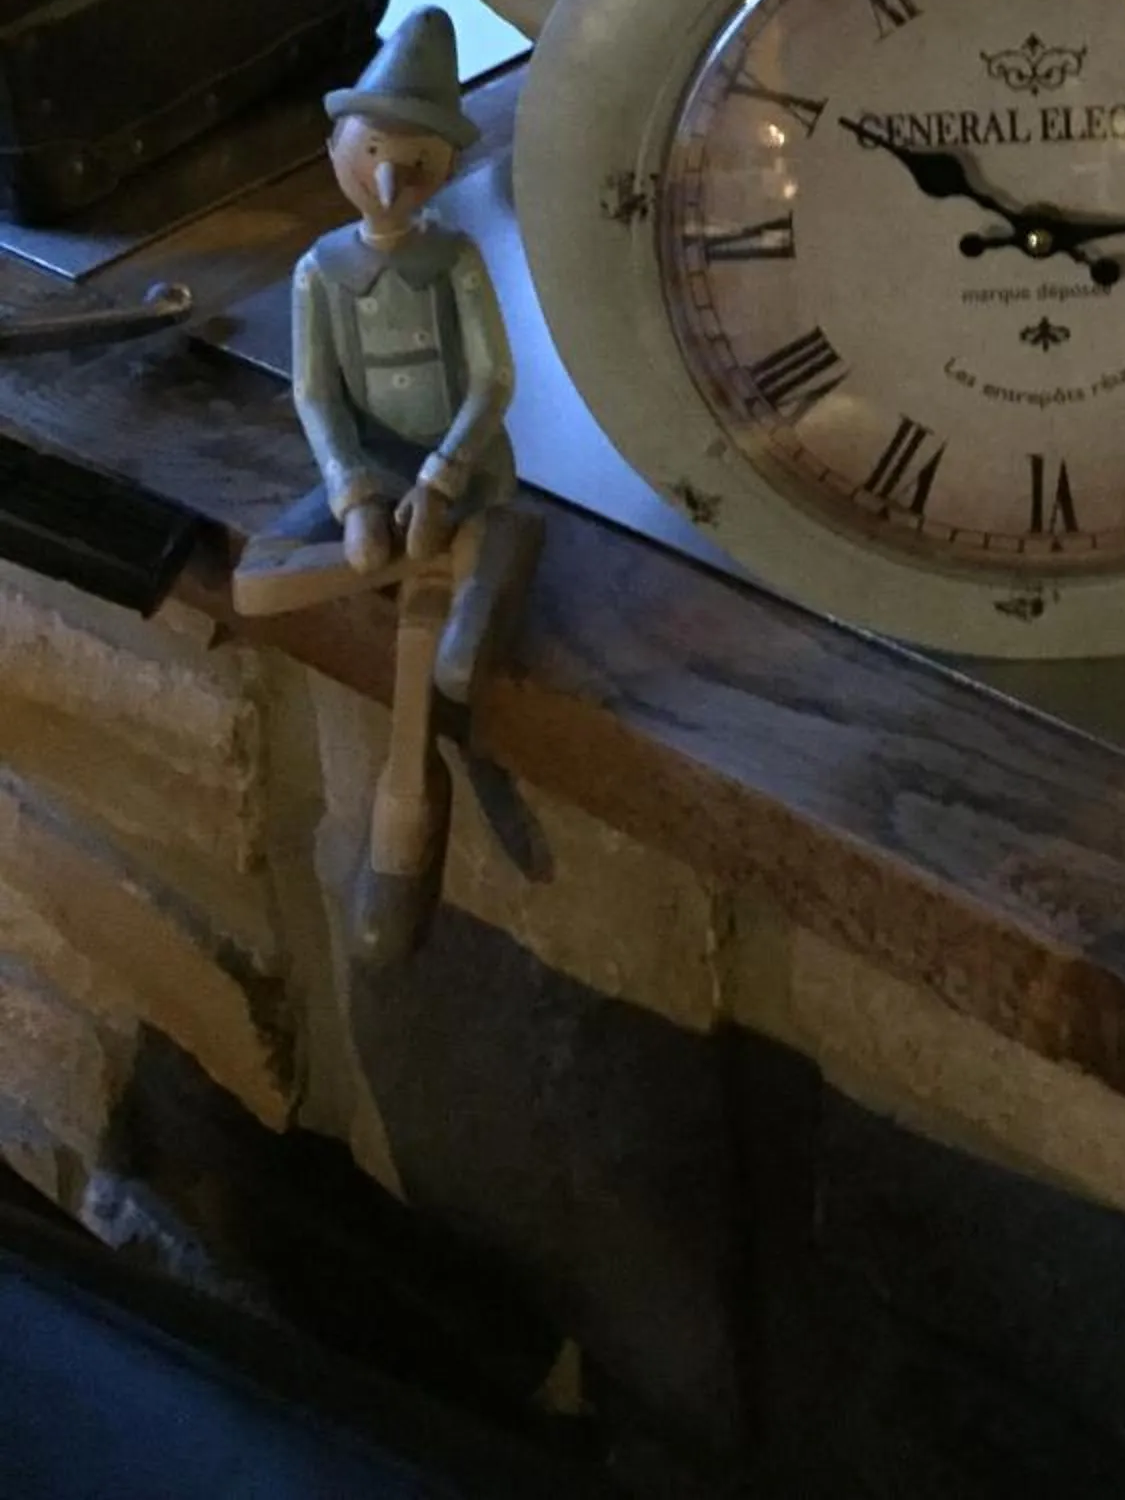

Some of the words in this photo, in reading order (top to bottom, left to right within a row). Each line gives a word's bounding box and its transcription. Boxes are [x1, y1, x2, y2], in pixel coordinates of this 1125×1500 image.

[857, 107, 1032, 150] GENERAL
[961, 286, 1031, 305] marque
[943, 356, 977, 389] Les
